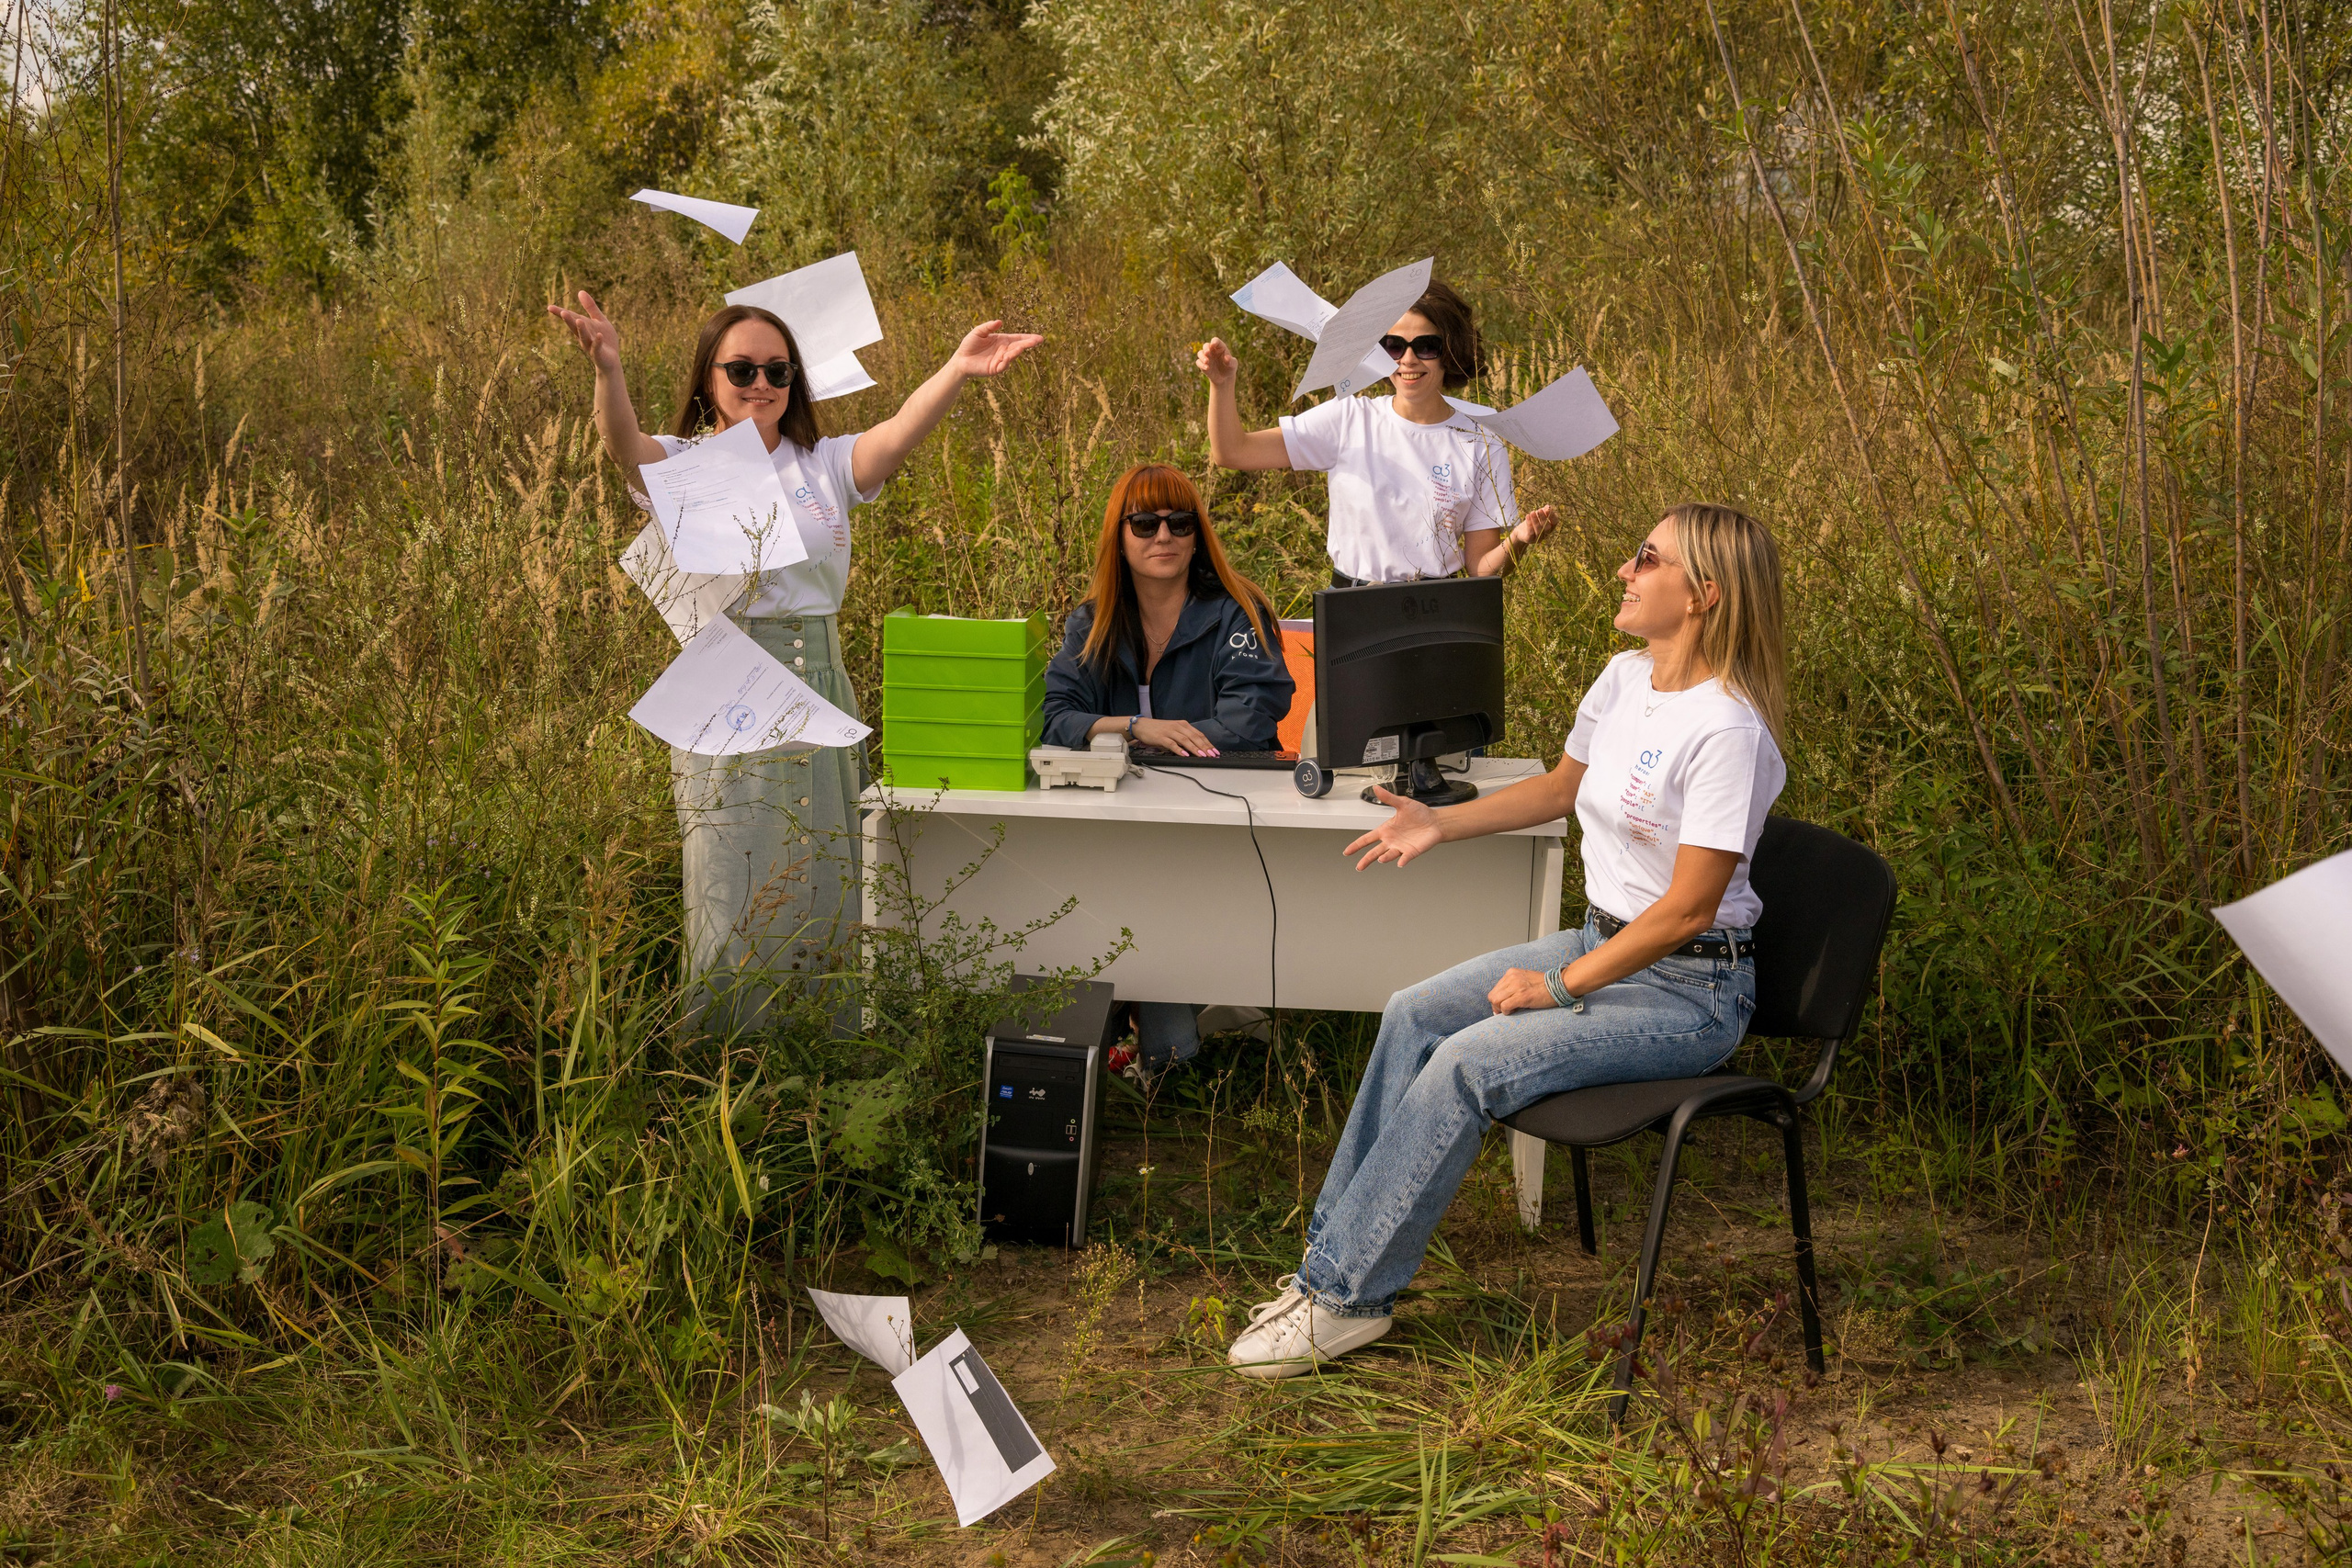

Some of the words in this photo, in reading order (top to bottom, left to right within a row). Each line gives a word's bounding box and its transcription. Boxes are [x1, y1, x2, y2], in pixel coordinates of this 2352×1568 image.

[1432, 463, 1450, 478] a3
[1421, 598, 1439, 615] LG
[1640, 750, 1663, 769] a3
